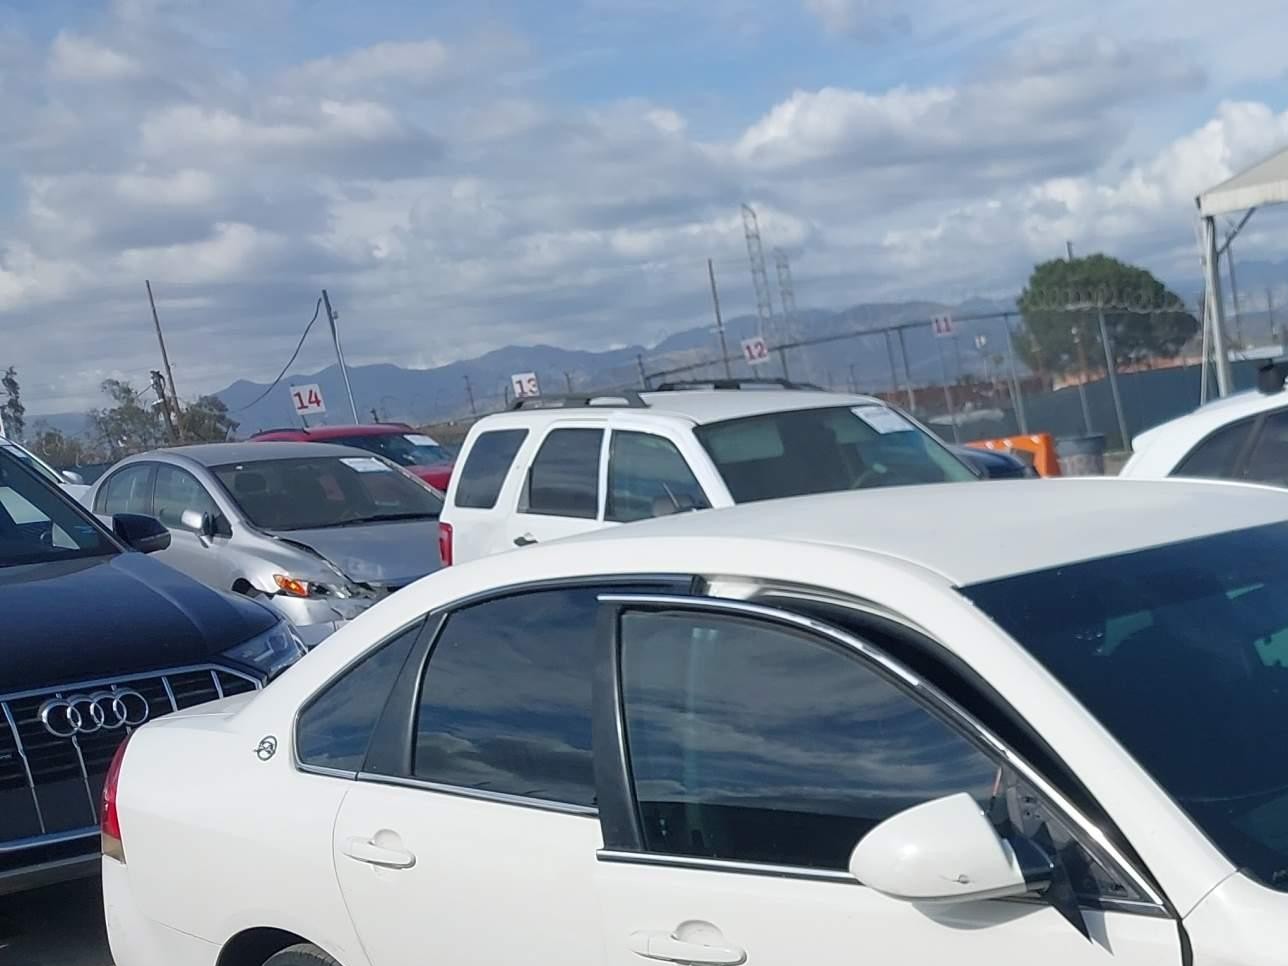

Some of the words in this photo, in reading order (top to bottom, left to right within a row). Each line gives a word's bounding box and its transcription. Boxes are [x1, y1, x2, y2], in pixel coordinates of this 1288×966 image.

[934, 317, 951, 334] 11
[745, 341, 768, 360] 12
[515, 378, 537, 397] 13
[293, 389, 321, 410] 14
